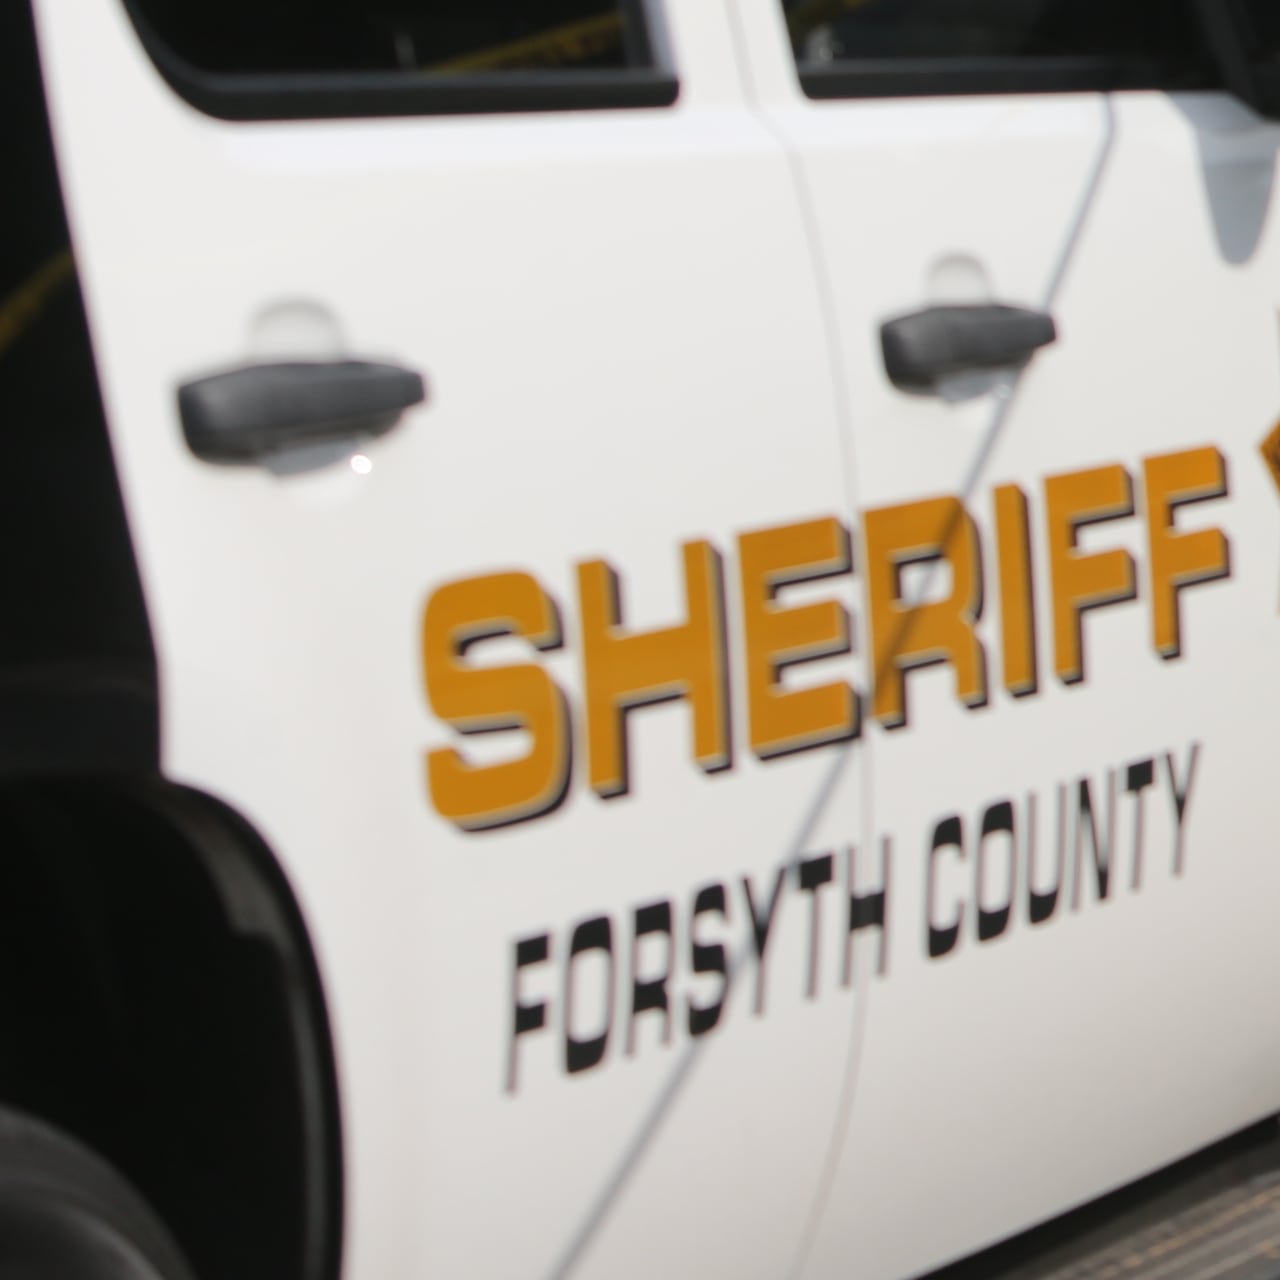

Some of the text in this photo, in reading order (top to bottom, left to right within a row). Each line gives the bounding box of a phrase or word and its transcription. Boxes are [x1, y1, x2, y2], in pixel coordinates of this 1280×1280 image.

[420, 445, 1232, 834] SHERIFF
[502, 740, 1203, 1098] FORSYTH COUNTY
